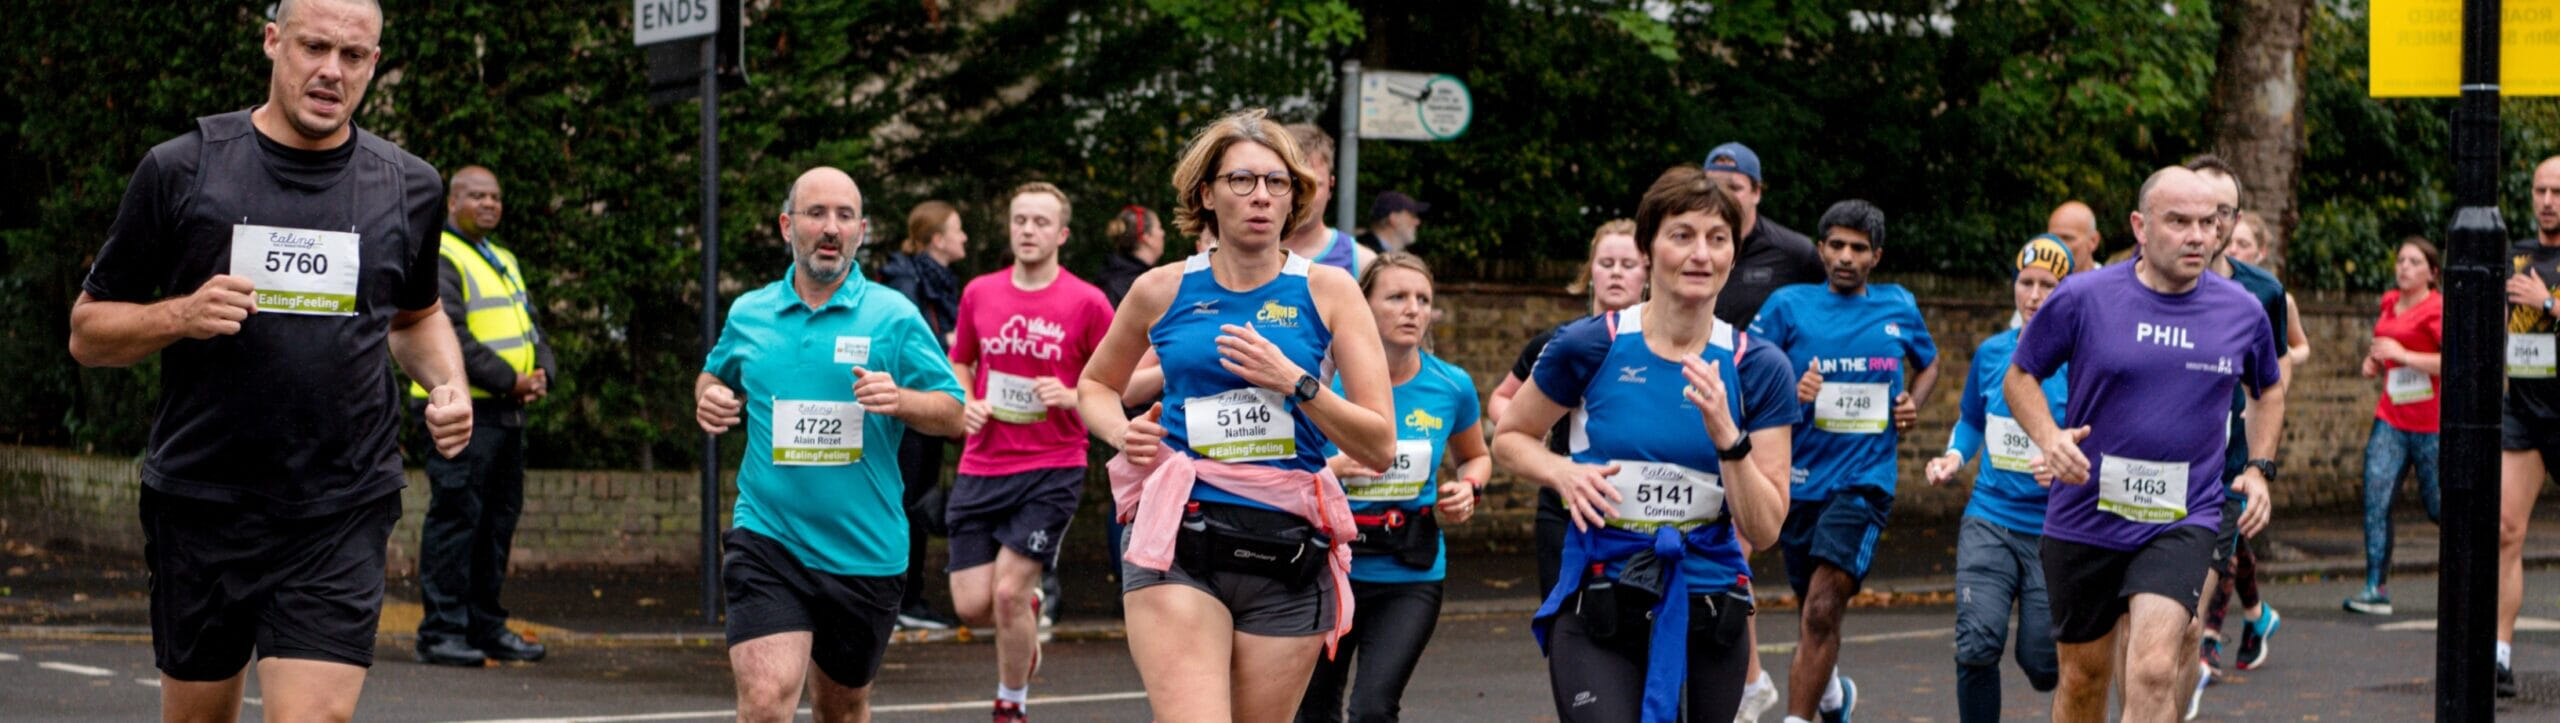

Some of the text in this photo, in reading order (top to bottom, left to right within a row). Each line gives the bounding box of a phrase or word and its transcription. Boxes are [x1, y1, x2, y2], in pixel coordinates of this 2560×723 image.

[642, 0, 708, 30] ENDS
[268, 232, 323, 249] Ealing
[265, 250, 328, 275] 5760
[258, 293, 340, 310] EalingFeeling
[2136, 322, 2195, 349] PHIL
[980, 328, 1062, 362] parkrun
[1839, 358, 1867, 372] THE
[1001, 387, 1033, 404] 1763
[1835, 396, 1872, 410] 4748
[1217, 404, 1272, 427] 5146
[794, 418, 842, 435] 4722
[1225, 426, 1267, 439] Nathalie
[794, 435, 815, 445] Alain
[2003, 433, 2030, 449] 393
[784, 449, 851, 461] #EalingFeeling
[1207, 443, 1284, 458] #EalingFeeling
[1636, 484, 1694, 505] 5141
[2122, 477, 2167, 496] 1463
[2133, 495, 2153, 505] Phil
[1644, 506, 1686, 518] Corinne
